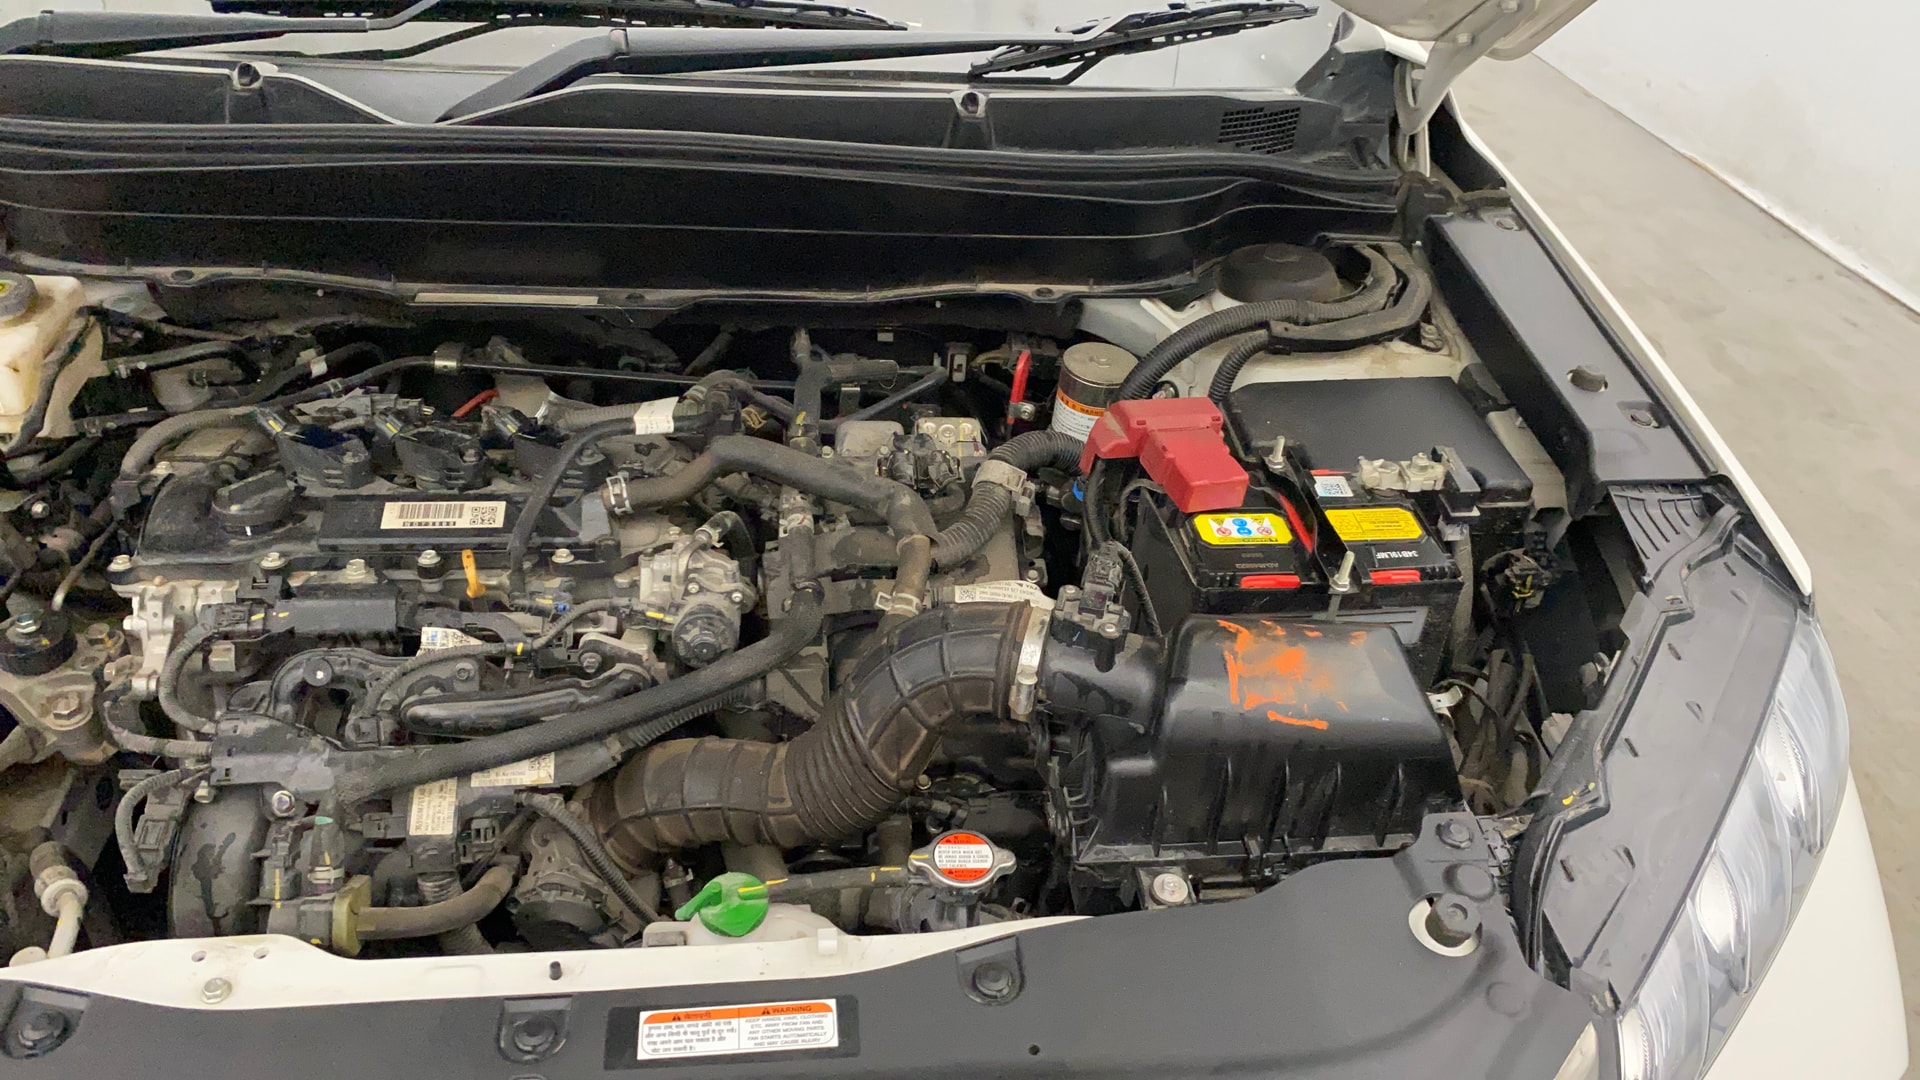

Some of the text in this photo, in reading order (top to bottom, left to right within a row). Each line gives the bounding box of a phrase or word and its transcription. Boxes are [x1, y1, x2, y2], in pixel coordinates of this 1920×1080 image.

[1375, 550, 1419, 560] 34B19LMF
[772, 1005, 812, 1014] WARNING
[783, 1031, 827, 1039] AUTOMATICALLY
